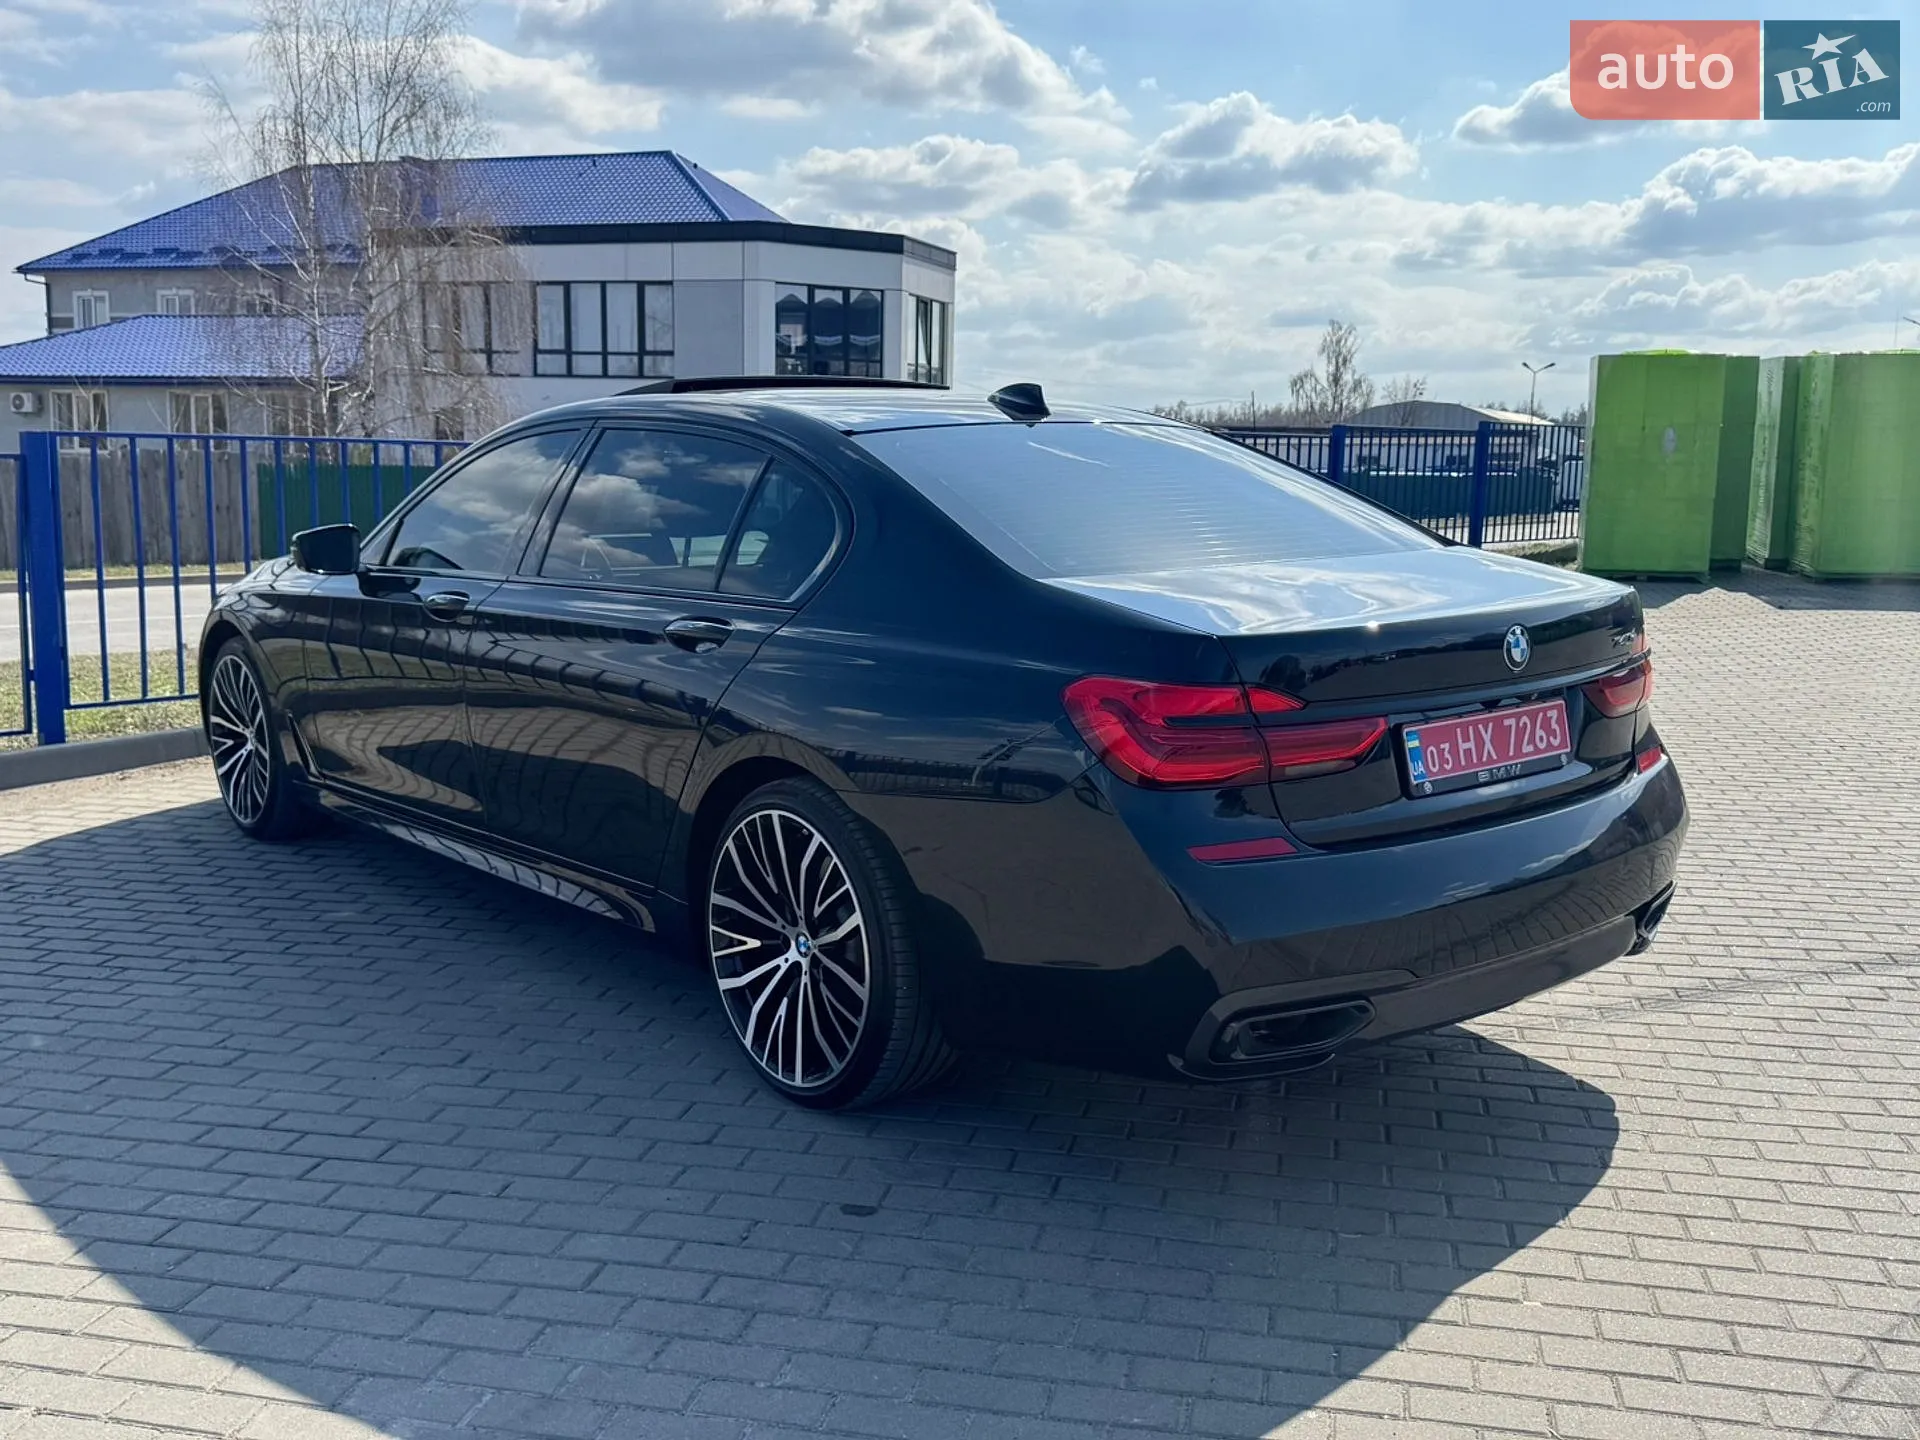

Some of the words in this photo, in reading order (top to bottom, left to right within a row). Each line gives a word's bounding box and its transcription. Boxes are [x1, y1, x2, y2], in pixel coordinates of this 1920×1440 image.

[1426, 742, 1453, 773] 03
[1455, 722, 1498, 766] HX
[1503, 709, 1562, 757] 7263
[1411, 759, 1426, 776] UA
[1477, 764, 1522, 782] BMW
